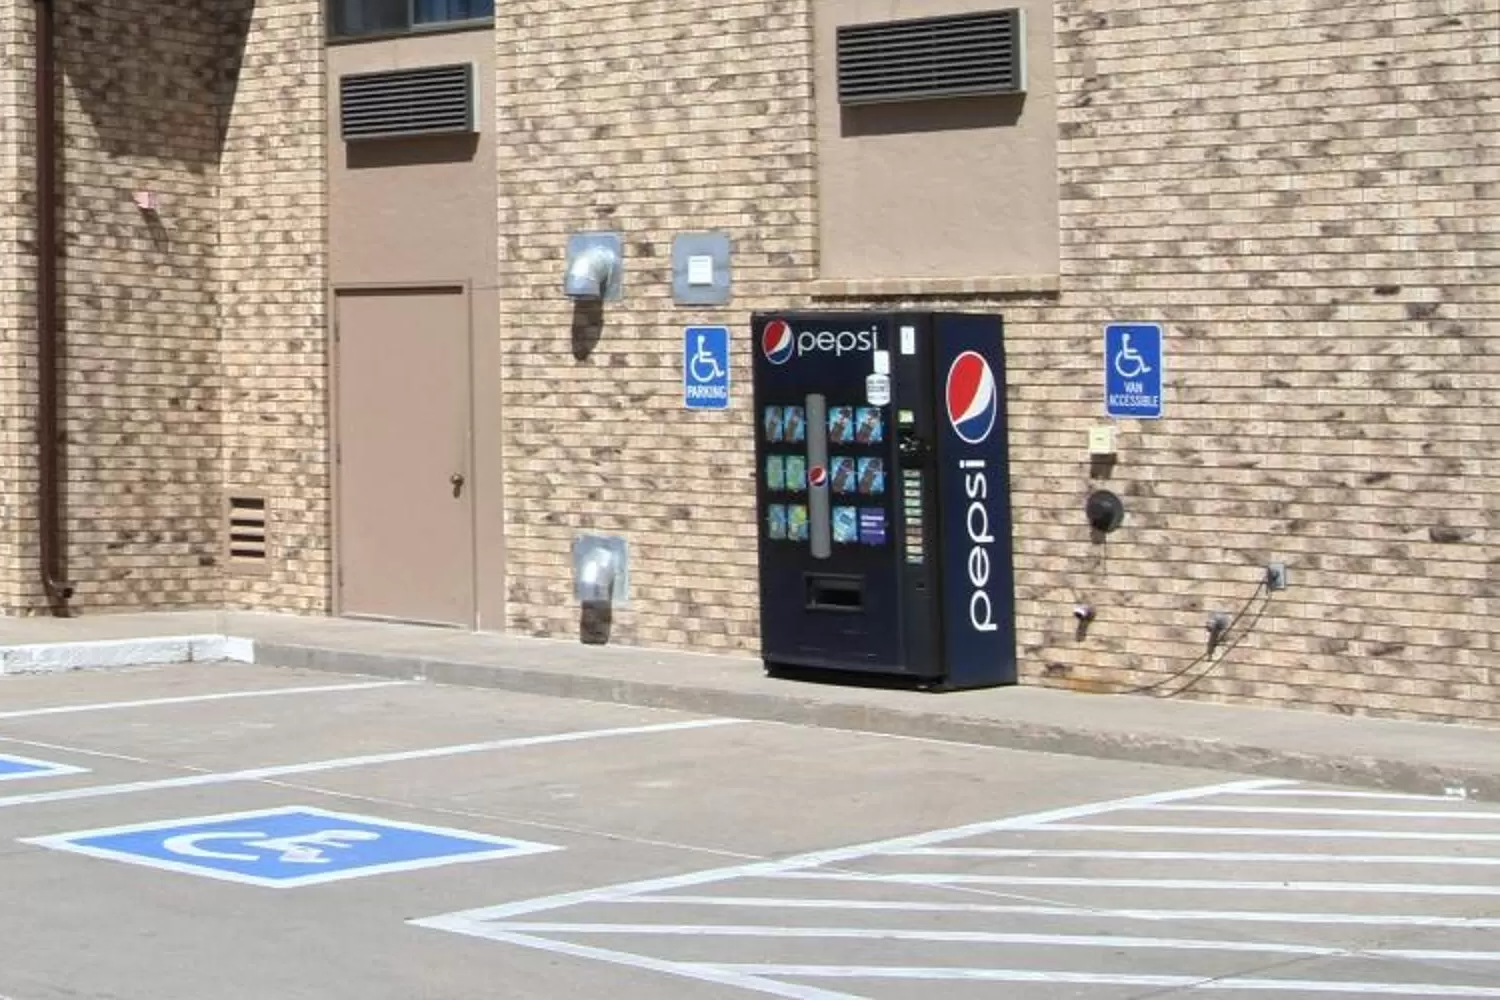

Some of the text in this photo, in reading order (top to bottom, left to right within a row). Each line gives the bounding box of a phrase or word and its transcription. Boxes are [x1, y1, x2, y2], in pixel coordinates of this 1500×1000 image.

[797, 325, 878, 357] pepsi
[687, 385, 727, 399] PARKING
[1123, 381, 1144, 394] VAN
[1109, 394, 1159, 407] ACCESSIBLE
[959, 459, 998, 632] pepsi
